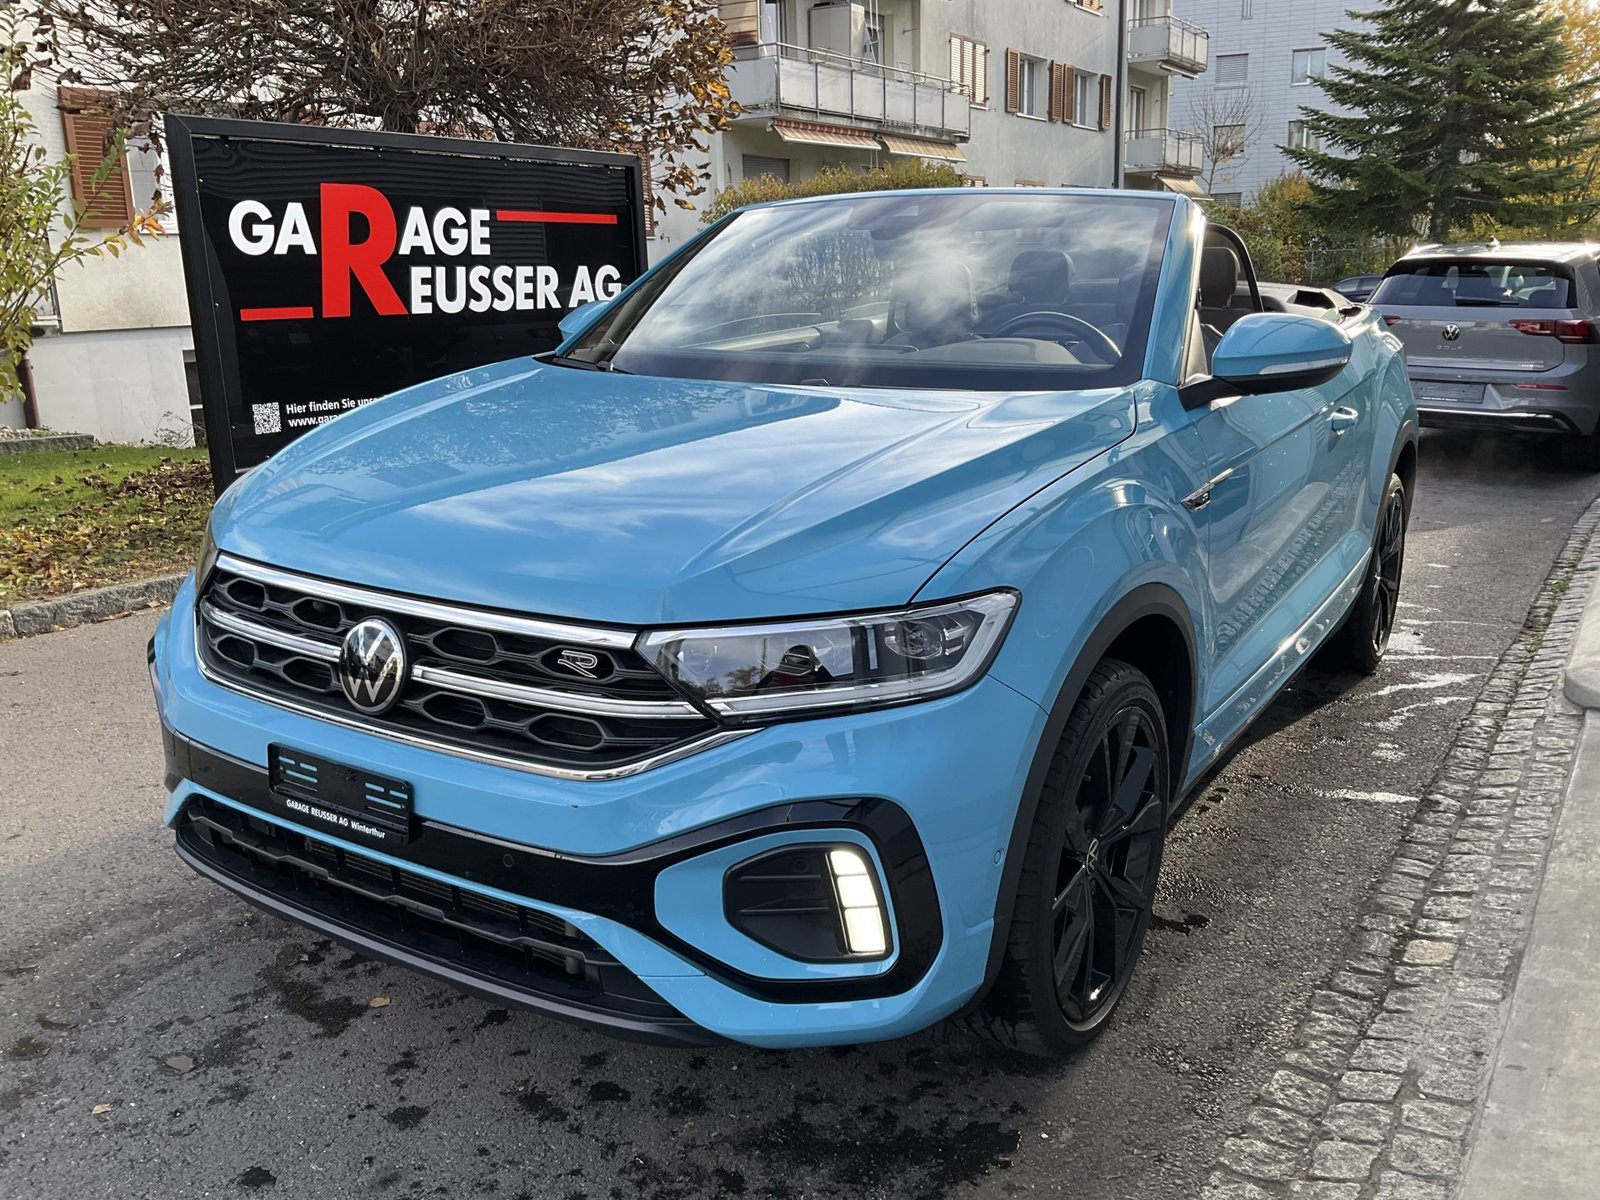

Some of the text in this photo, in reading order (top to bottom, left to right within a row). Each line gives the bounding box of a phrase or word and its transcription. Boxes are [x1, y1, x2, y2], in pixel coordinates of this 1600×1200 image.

[228, 182, 491, 318] GARAGE
[568, 264, 622, 308] AG
[286, 403, 307, 415] Hier
[308, 400, 340, 412] finden
[341, 398, 356, 409] Sie
[286, 799, 386, 839] GARAGE REUSSER AG Winterthur
